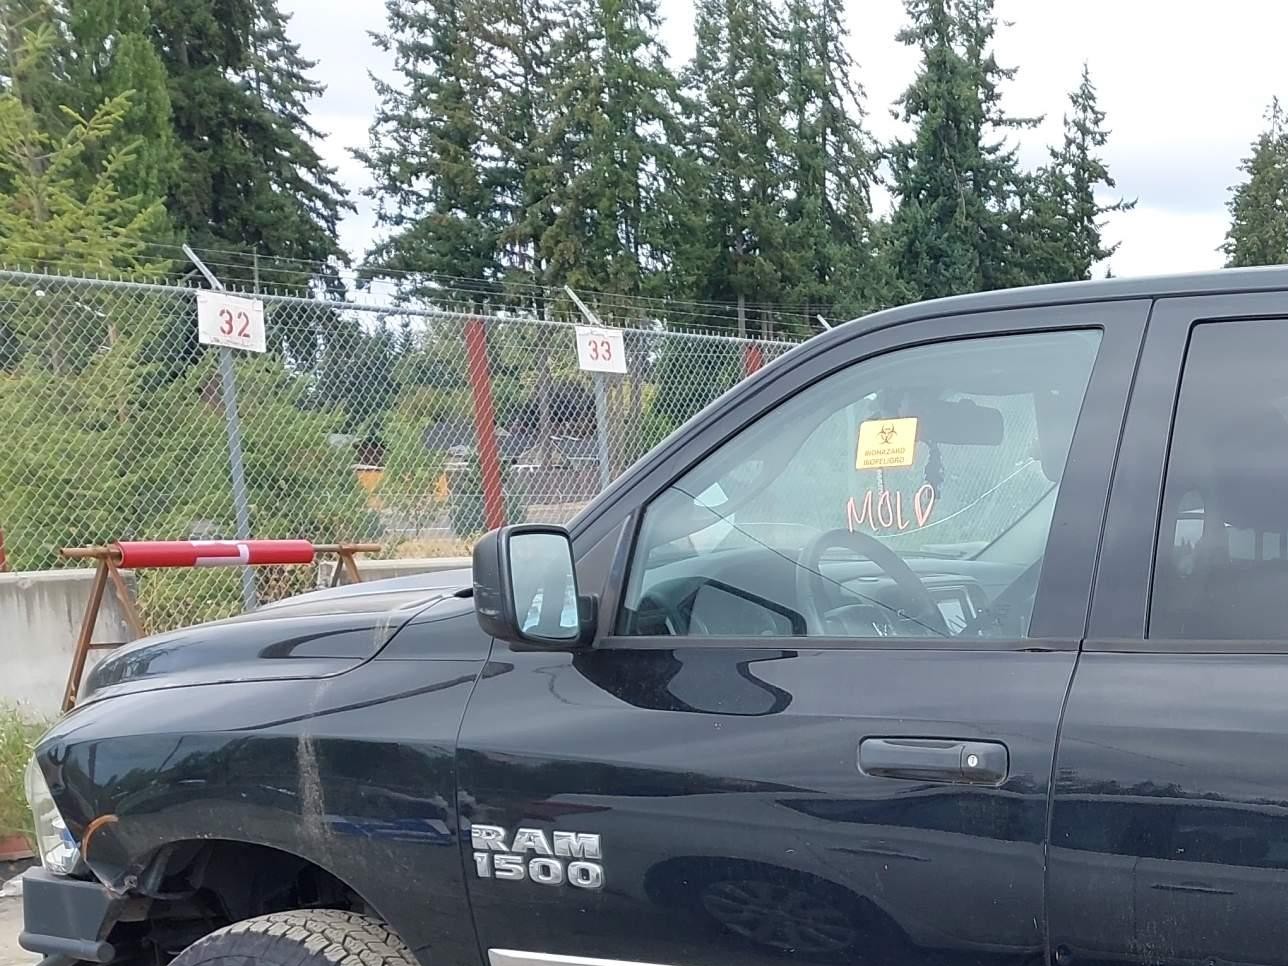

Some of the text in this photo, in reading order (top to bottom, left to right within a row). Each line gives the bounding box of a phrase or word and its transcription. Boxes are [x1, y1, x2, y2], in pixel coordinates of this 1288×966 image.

[218, 308, 251, 338] 32
[587, 338, 613, 363] 33
[846, 484, 935, 533] MOLD
[471, 824, 602, 859] RAM
[473, 852, 604, 888] 1500
